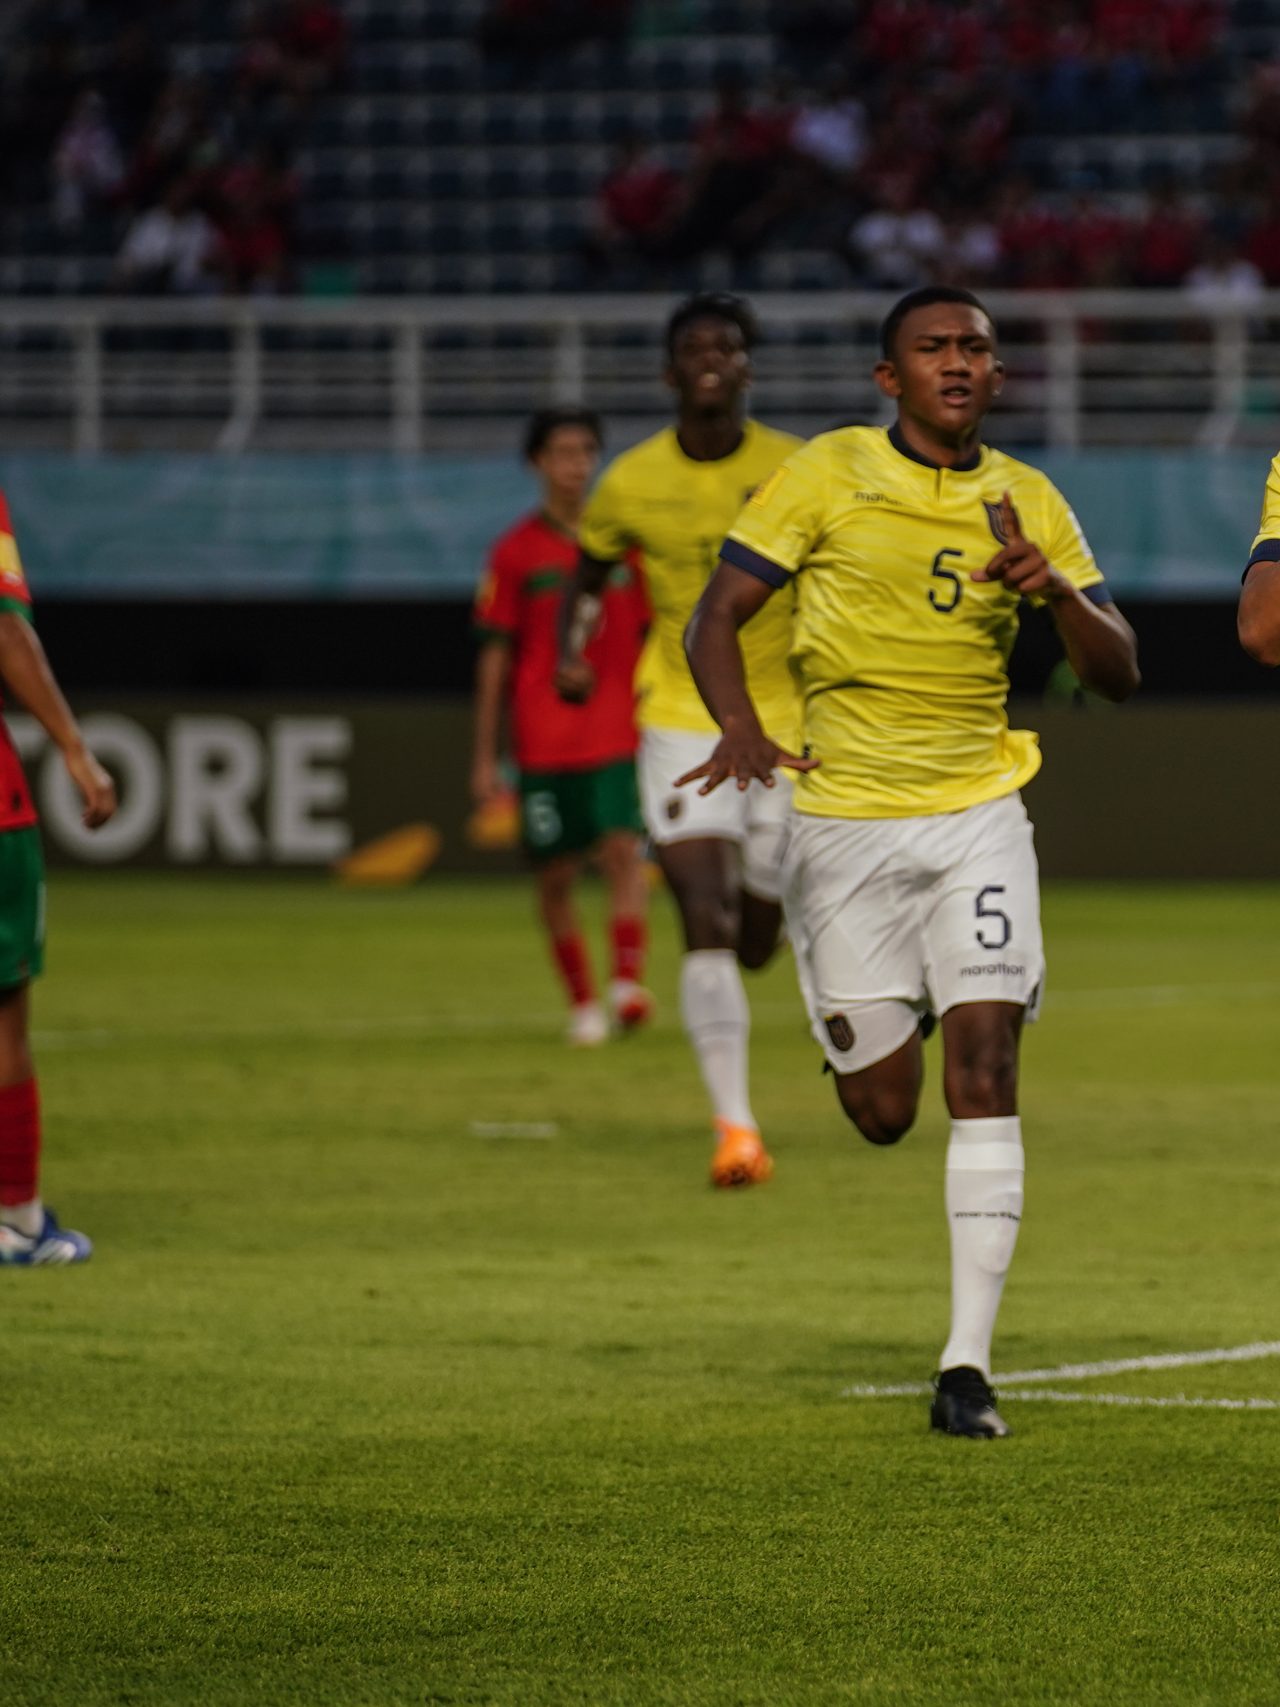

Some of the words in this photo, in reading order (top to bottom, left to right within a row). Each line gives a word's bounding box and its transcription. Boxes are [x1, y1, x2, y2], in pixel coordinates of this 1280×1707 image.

[928, 547, 963, 612] 5
[976, 885, 1011, 949] 5
[959, 963, 1026, 977] marathon
